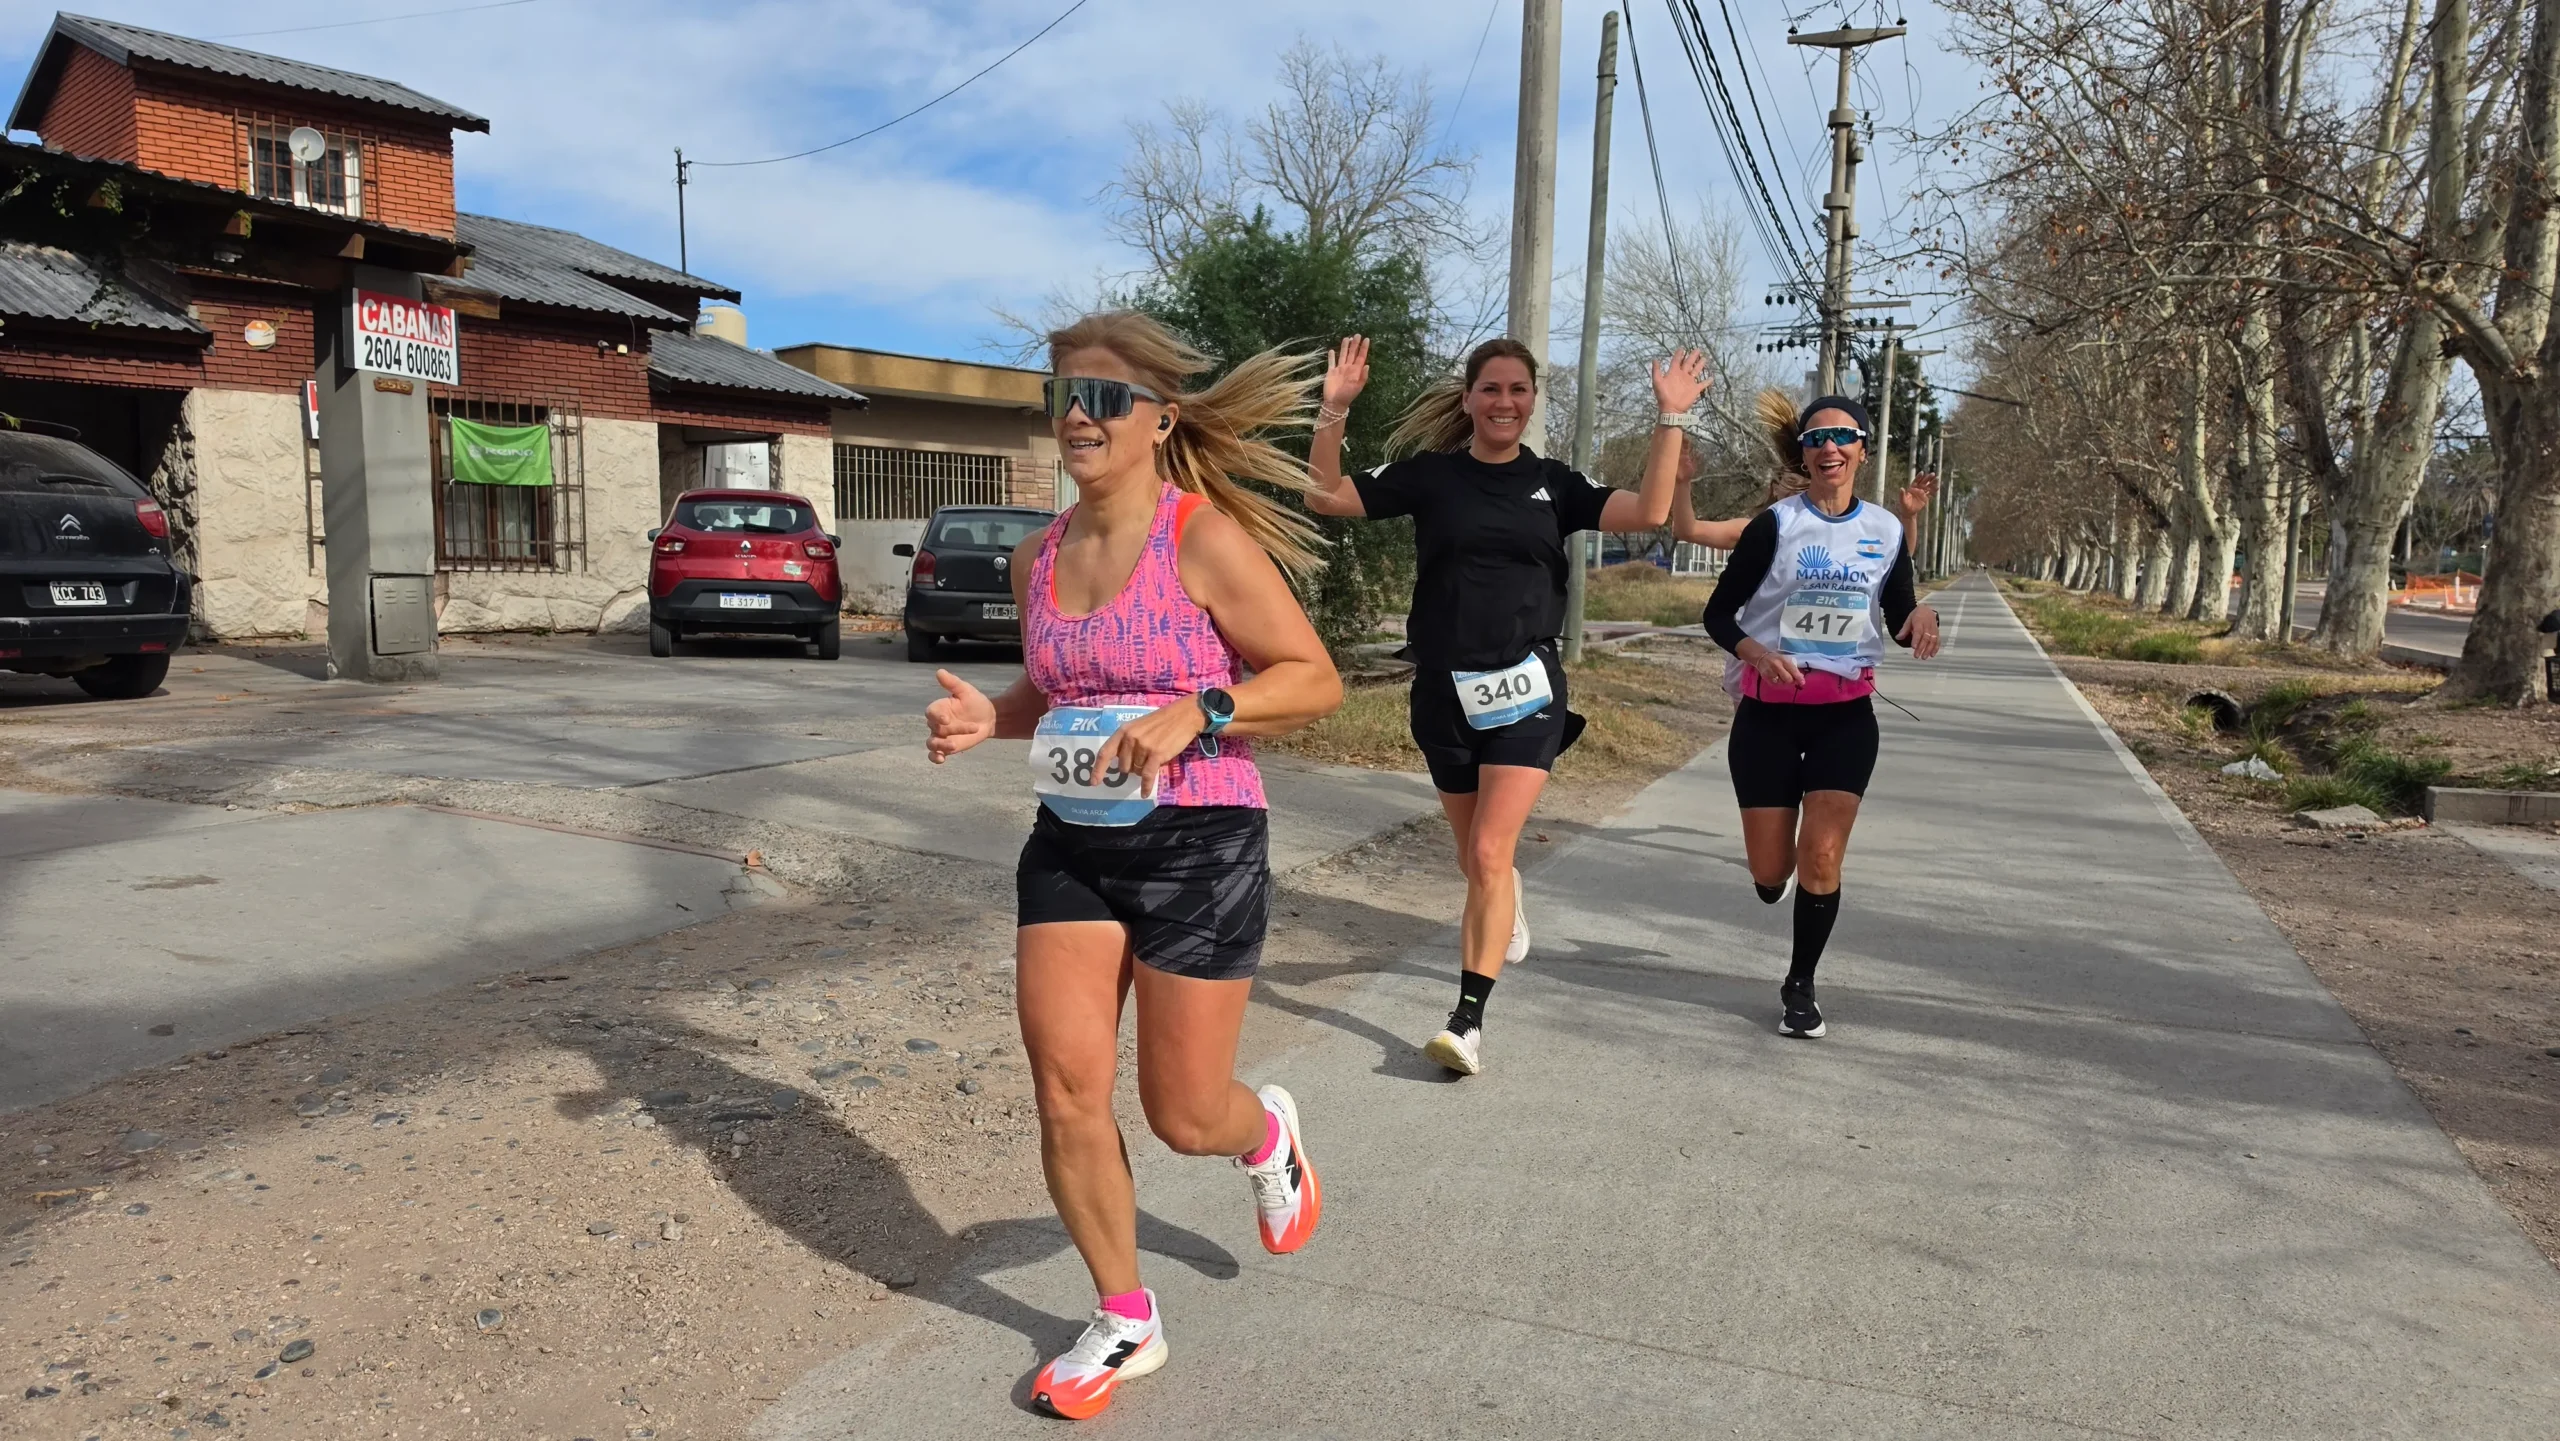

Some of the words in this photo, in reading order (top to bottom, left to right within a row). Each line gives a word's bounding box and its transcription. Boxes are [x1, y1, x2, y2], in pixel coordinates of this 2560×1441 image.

[362, 299, 451, 347] CABAÑAS
[364, 335, 402, 371] 2604
[406, 342, 452, 381] 600863
[53, 586, 77, 601] KCC
[81, 586, 104, 601] 743
[1809, 582, 1830, 590] SAN
[723, 597, 735, 607] AE
[737, 597, 755, 607] 317
[757, 598, 769, 608] VP
[1815, 595, 1840, 606] 21K
[1795, 612, 1853, 636] 417
[1474, 673, 1532, 706] 340
[1070, 716, 1100, 731] 21K
